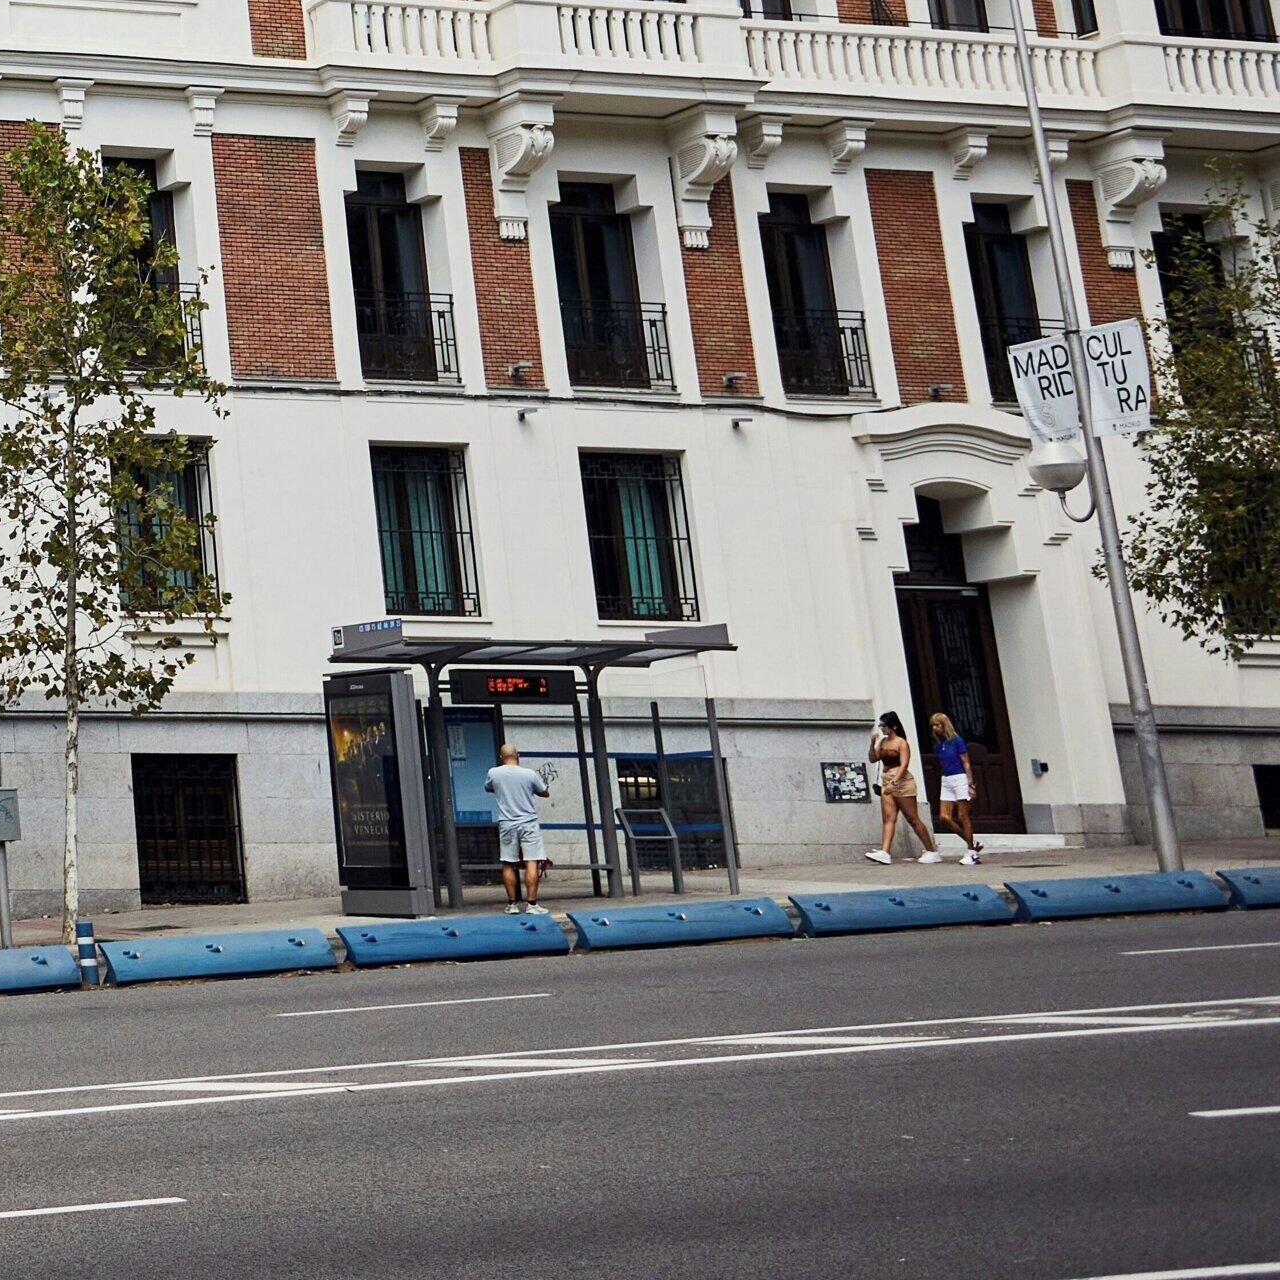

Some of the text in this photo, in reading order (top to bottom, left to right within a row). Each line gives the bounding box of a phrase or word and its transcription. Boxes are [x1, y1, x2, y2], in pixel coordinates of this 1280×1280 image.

[1086, 331, 1132, 361] CUL
[1013, 344, 1069, 379] MAD
[1096, 358, 1128, 387] TU
[1116, 384, 1148, 413] RA
